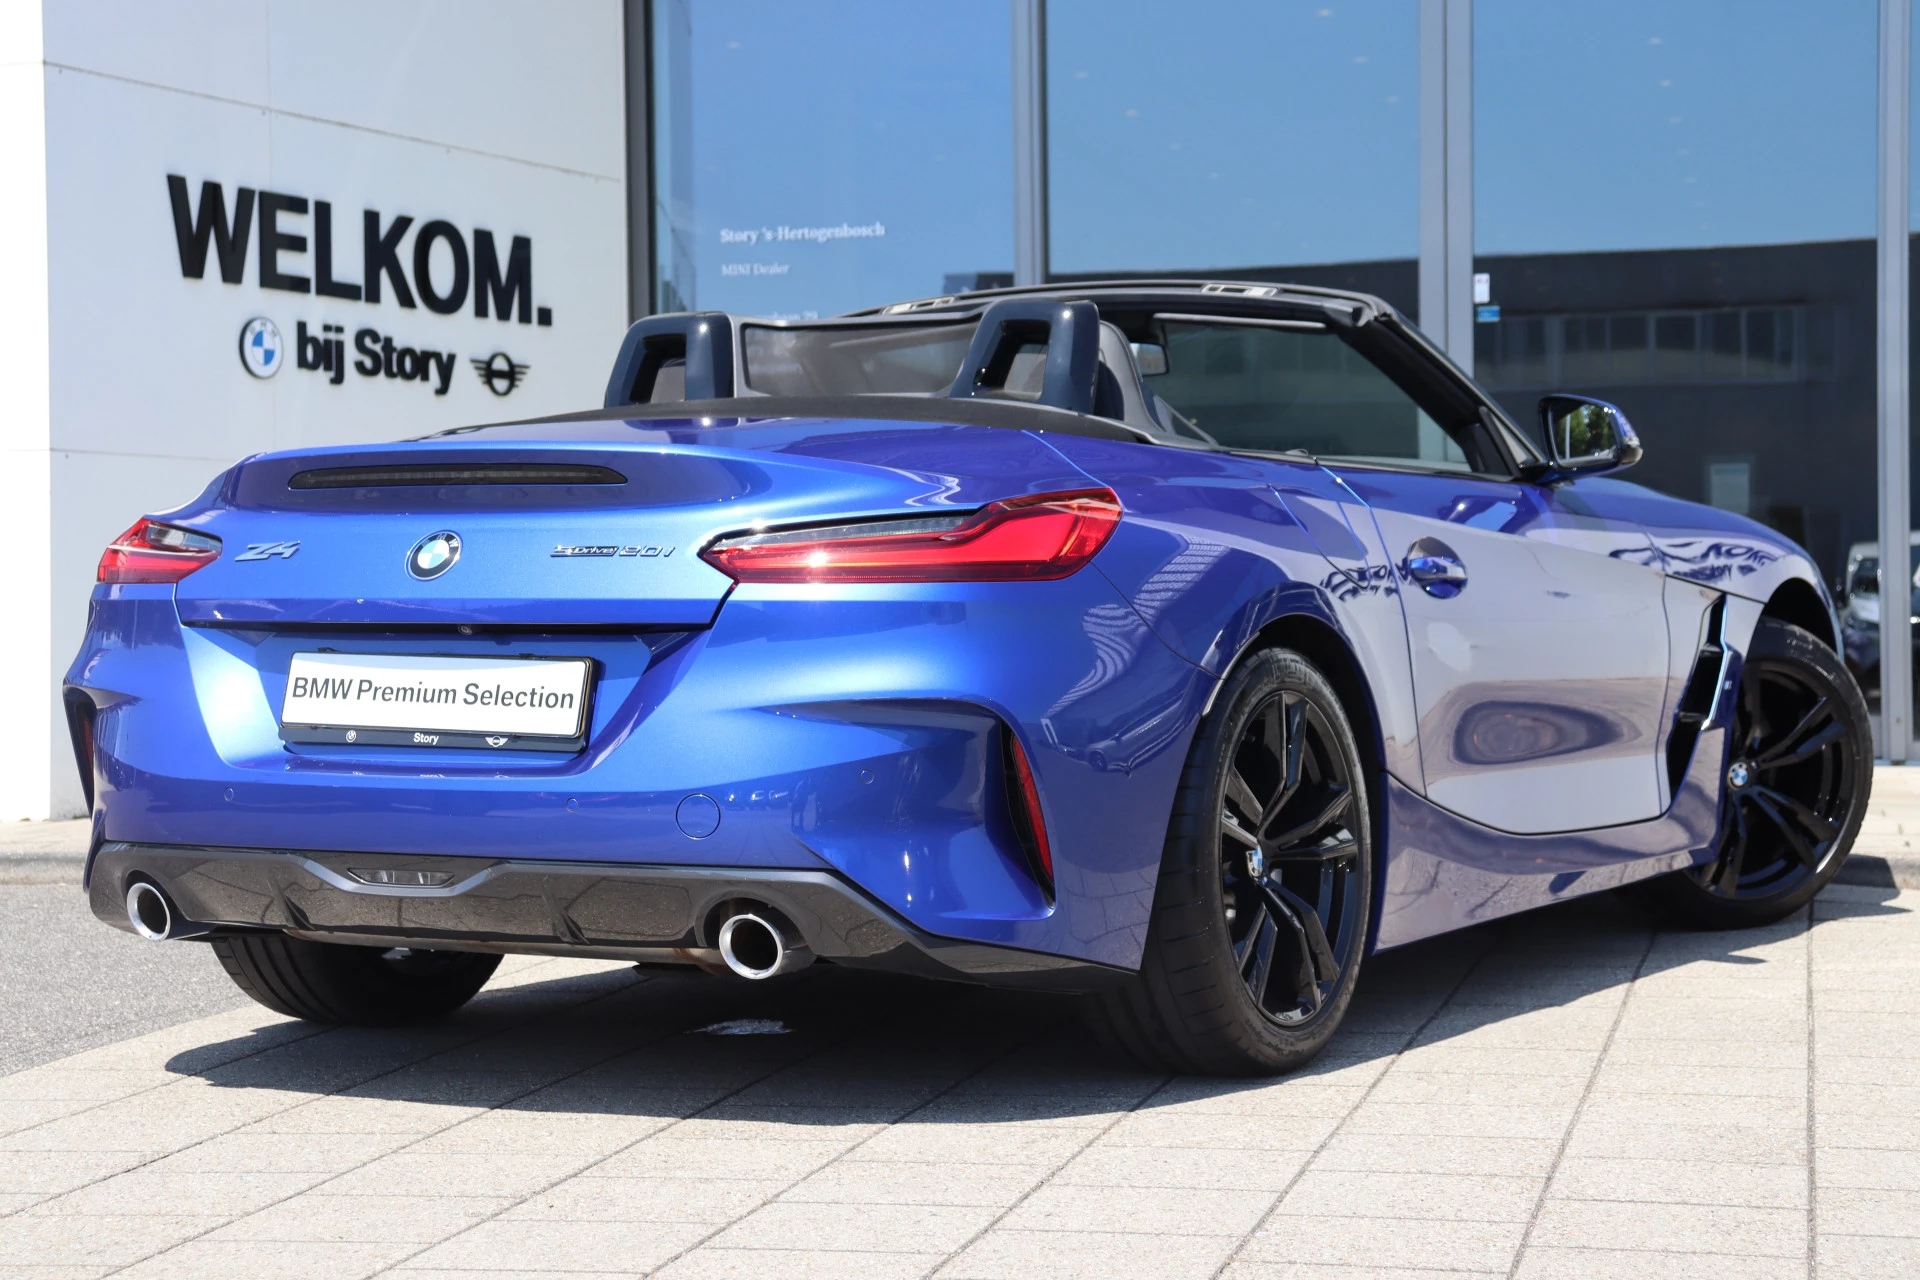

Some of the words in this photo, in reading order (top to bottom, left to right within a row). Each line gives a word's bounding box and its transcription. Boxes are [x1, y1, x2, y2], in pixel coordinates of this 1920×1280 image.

[720, 228, 758, 246] Story
[167, 173, 553, 327] WELKOM.
[721, 263, 751, 277] MINI
[753, 262, 789, 275] Dealer
[296, 321, 345, 385] bij
[354, 328, 457, 396] Story
[235, 541, 301, 562] Z4
[292, 677, 353, 700] BMW
[357, 679, 457, 704] Premium
[463, 683, 574, 709] Selection
[413, 732, 439, 745] Story
